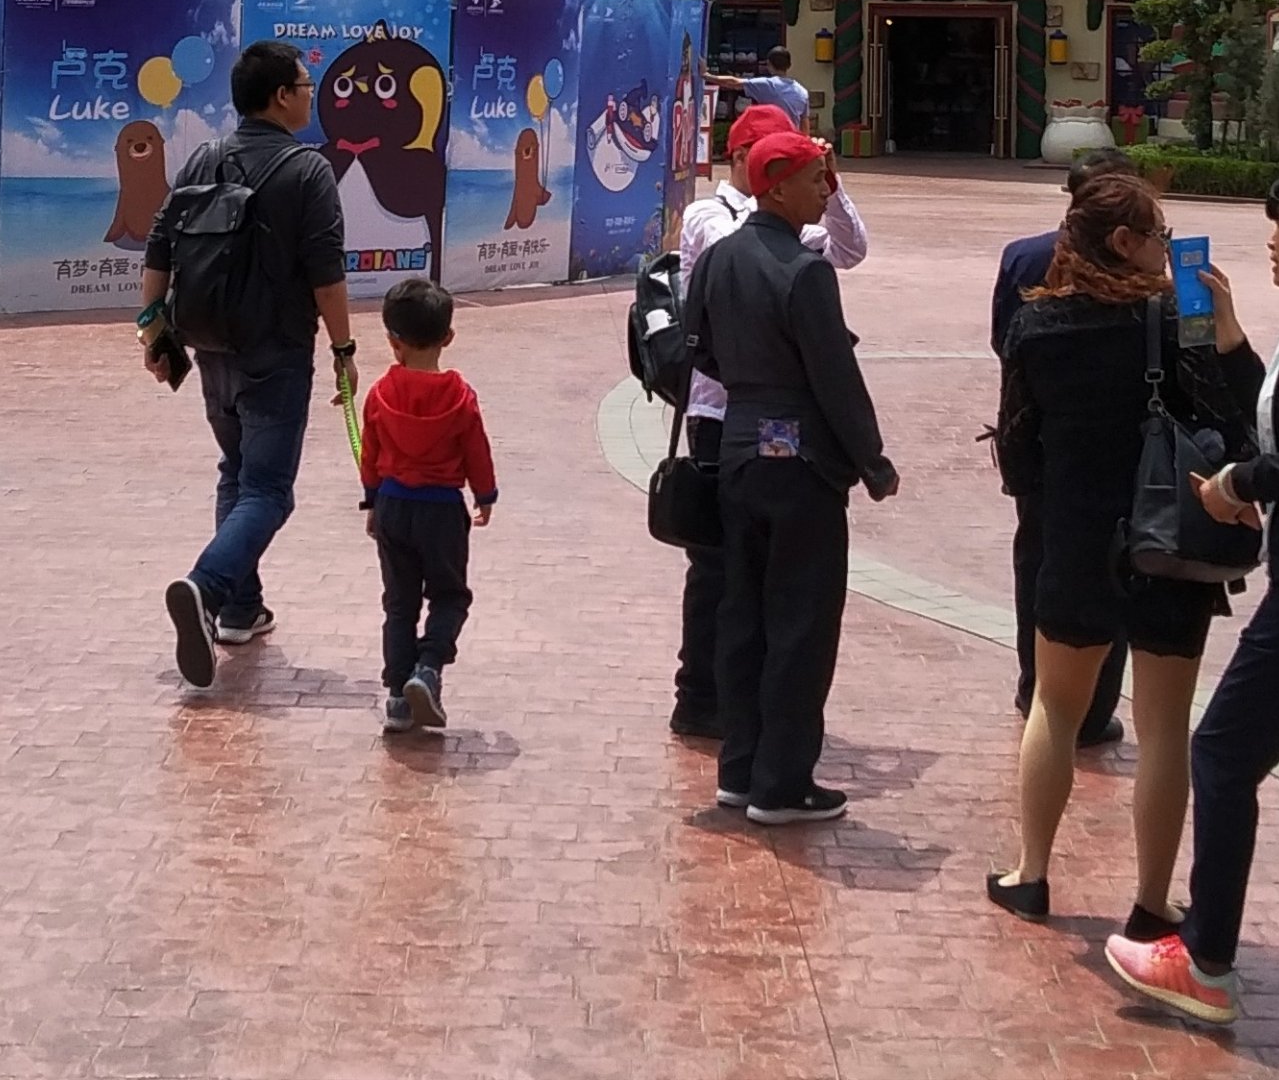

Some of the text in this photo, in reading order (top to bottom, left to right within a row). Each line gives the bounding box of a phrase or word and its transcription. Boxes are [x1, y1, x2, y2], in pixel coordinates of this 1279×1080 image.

[273, 23, 424, 40] DREAM LOVE JOY
[51, 39, 129, 90] 卢克
[472, 45, 518, 90] 卢克
[48, 94, 130, 121] Luke
[470, 95, 518, 119] Luke
[344, 247, 427, 272] RDIANS
[70, 283, 110, 295] DREAM
